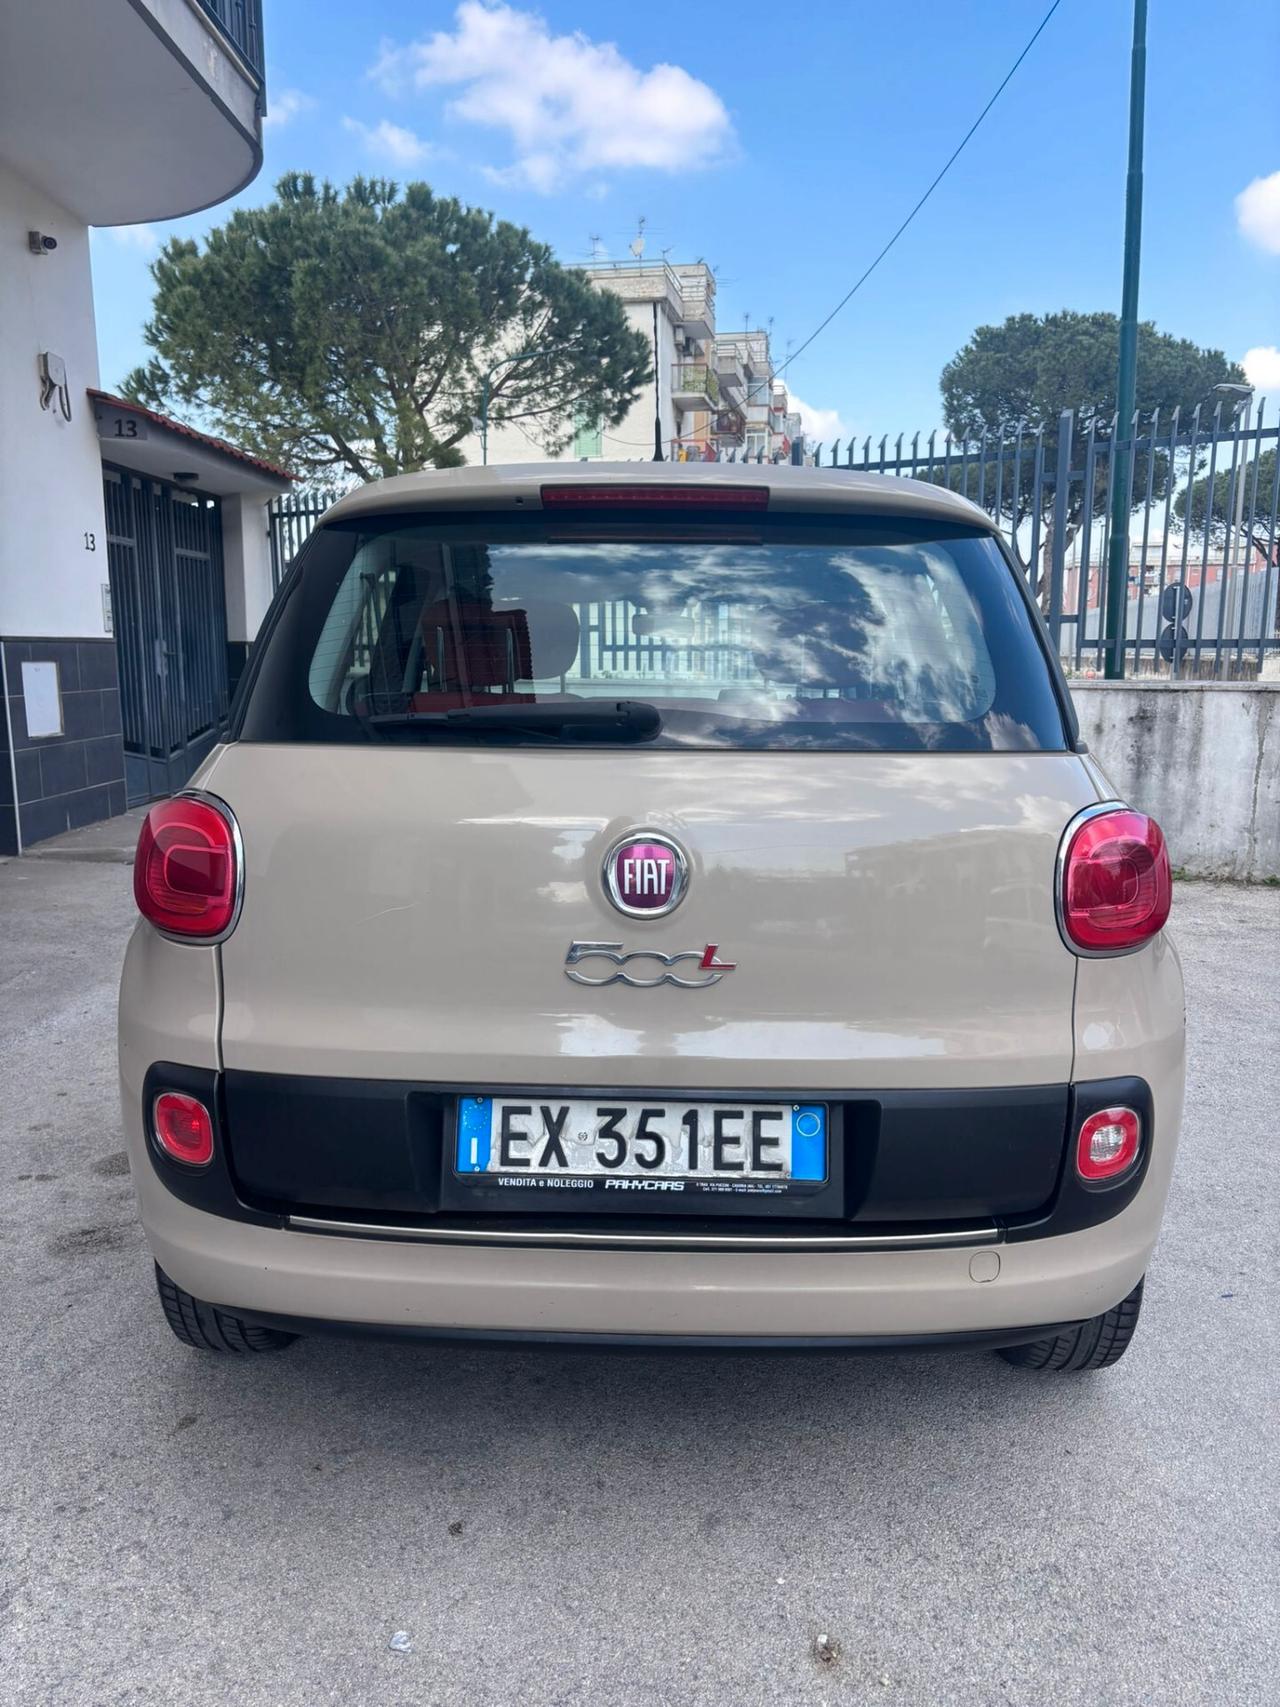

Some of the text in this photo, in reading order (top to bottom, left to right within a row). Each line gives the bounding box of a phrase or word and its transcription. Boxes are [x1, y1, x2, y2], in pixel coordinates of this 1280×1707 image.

[114, 418, 138, 438] 13
[84, 532, 96, 552] 13
[623, 859, 670, 895] FIAT
[500, 1105, 570, 1169] EX
[498, 1177, 537, 1187] VENDITA
[546, 1179, 594, 1189] NOLEGGIO
